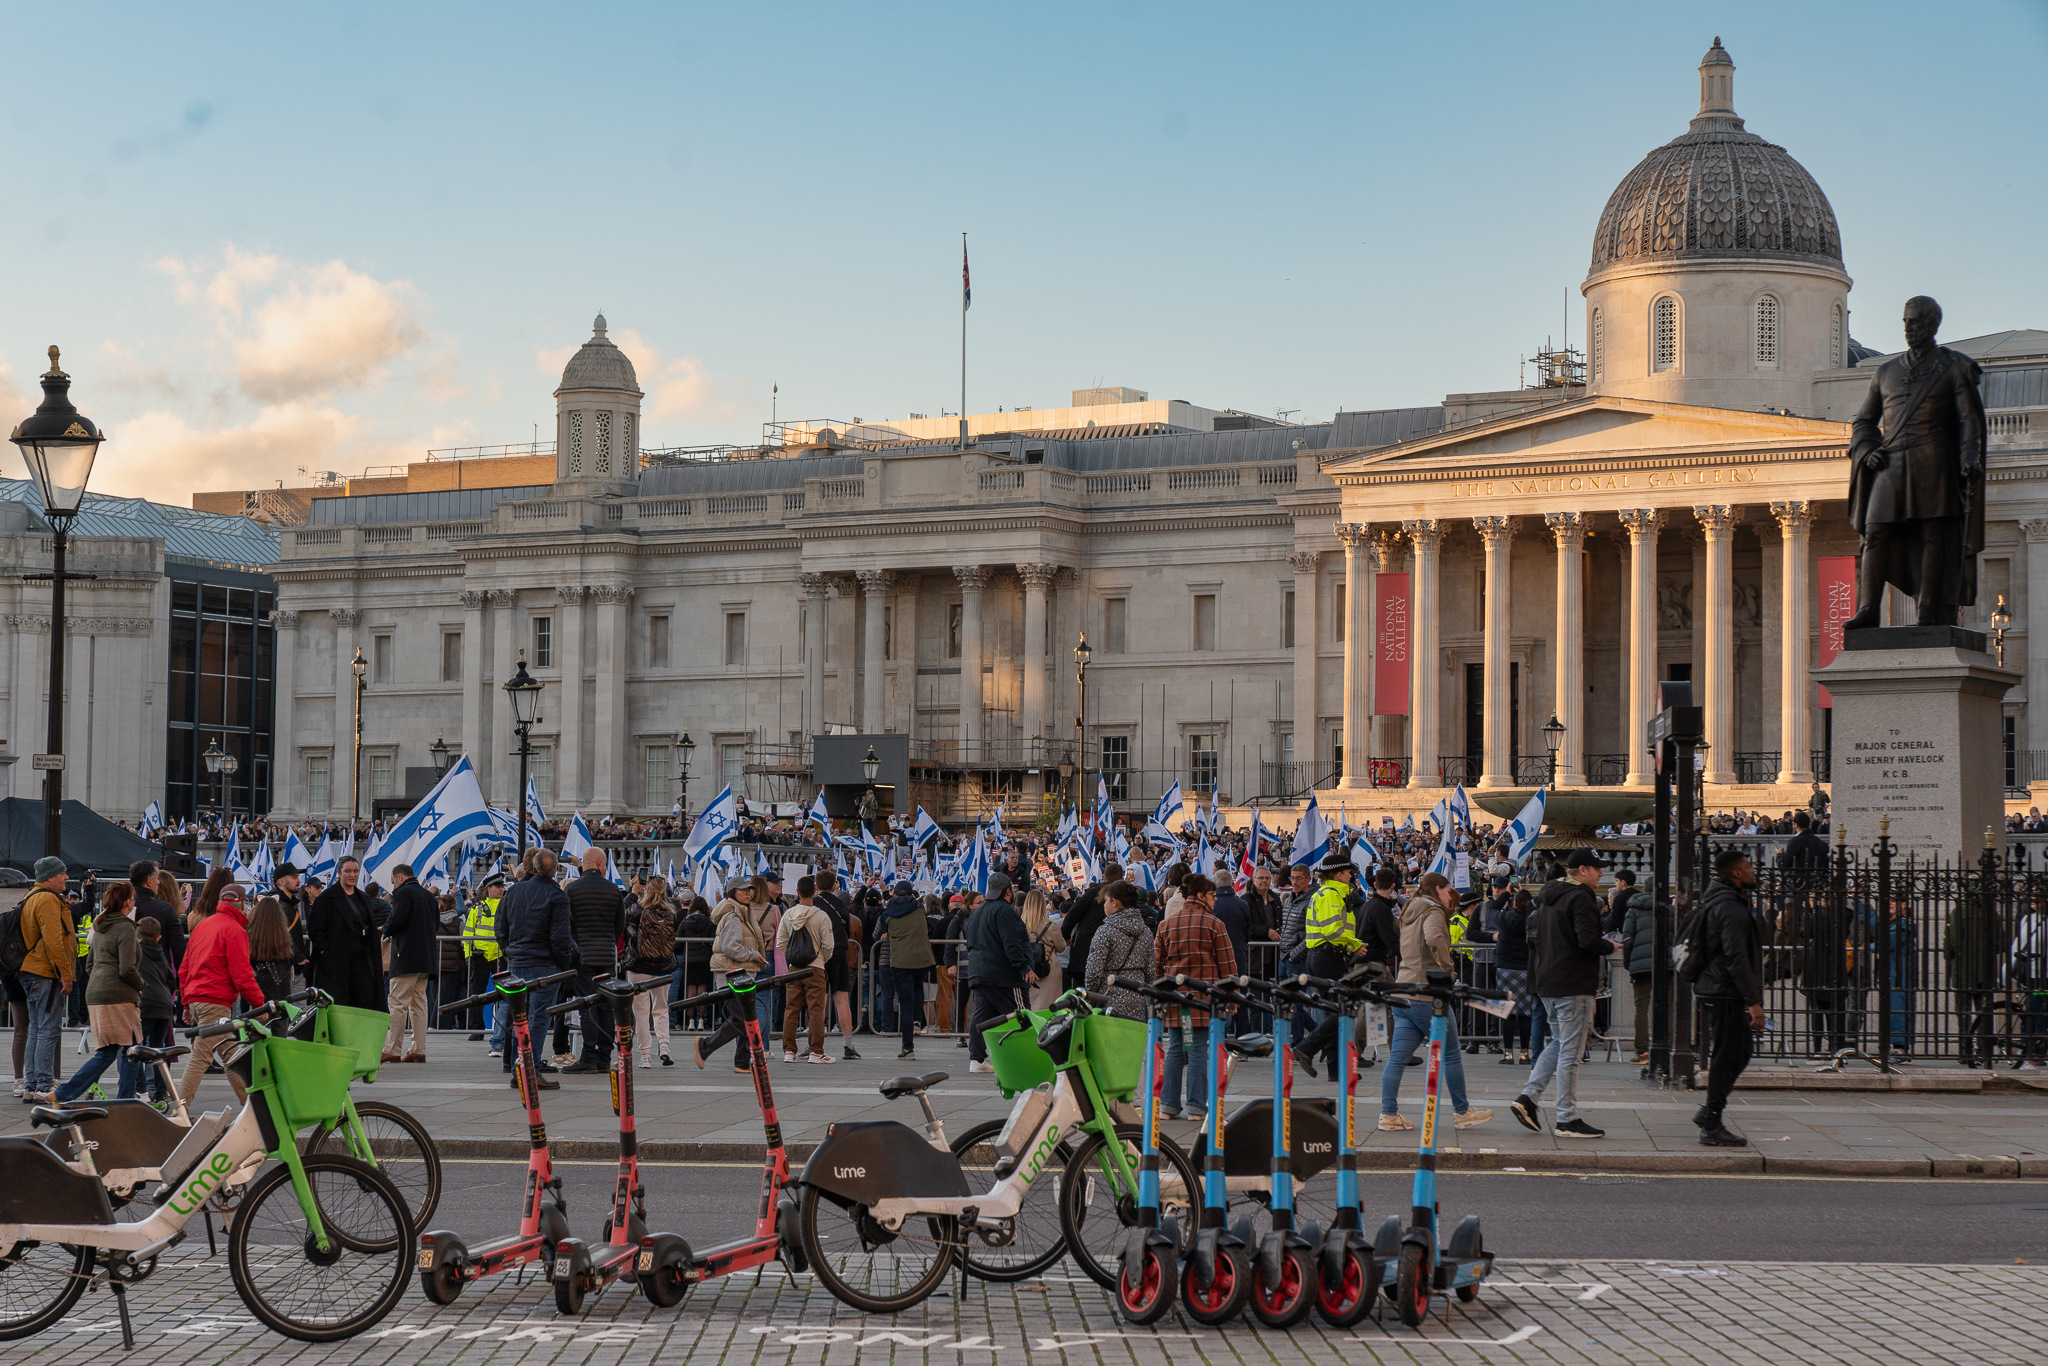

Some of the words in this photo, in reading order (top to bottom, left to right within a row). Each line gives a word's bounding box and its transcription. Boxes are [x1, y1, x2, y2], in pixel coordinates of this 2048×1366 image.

[1452, 482, 1495, 497] THE
[1511, 475, 1632, 494] NATIONAL
[1648, 467, 1759, 486] GALLERY
[1386, 595, 1394, 661] NATIONAL
[1395, 596, 1406, 661] GALLERY
[1829, 581, 1839, 651] NATIONAL
[1855, 742, 1886, 750] MAJOR
[1891, 741, 1935, 749] GENERAL
[1865, 756, 1895, 764] HENRY
[1898, 755, 1944, 763] HAVELOCK
[1018, 1125, 1061, 1184] Lime
[1303, 1141, 1332, 1153] Lime
[168, 1153, 233, 1215] Lime
[833, 1166, 866, 1178] Lime
